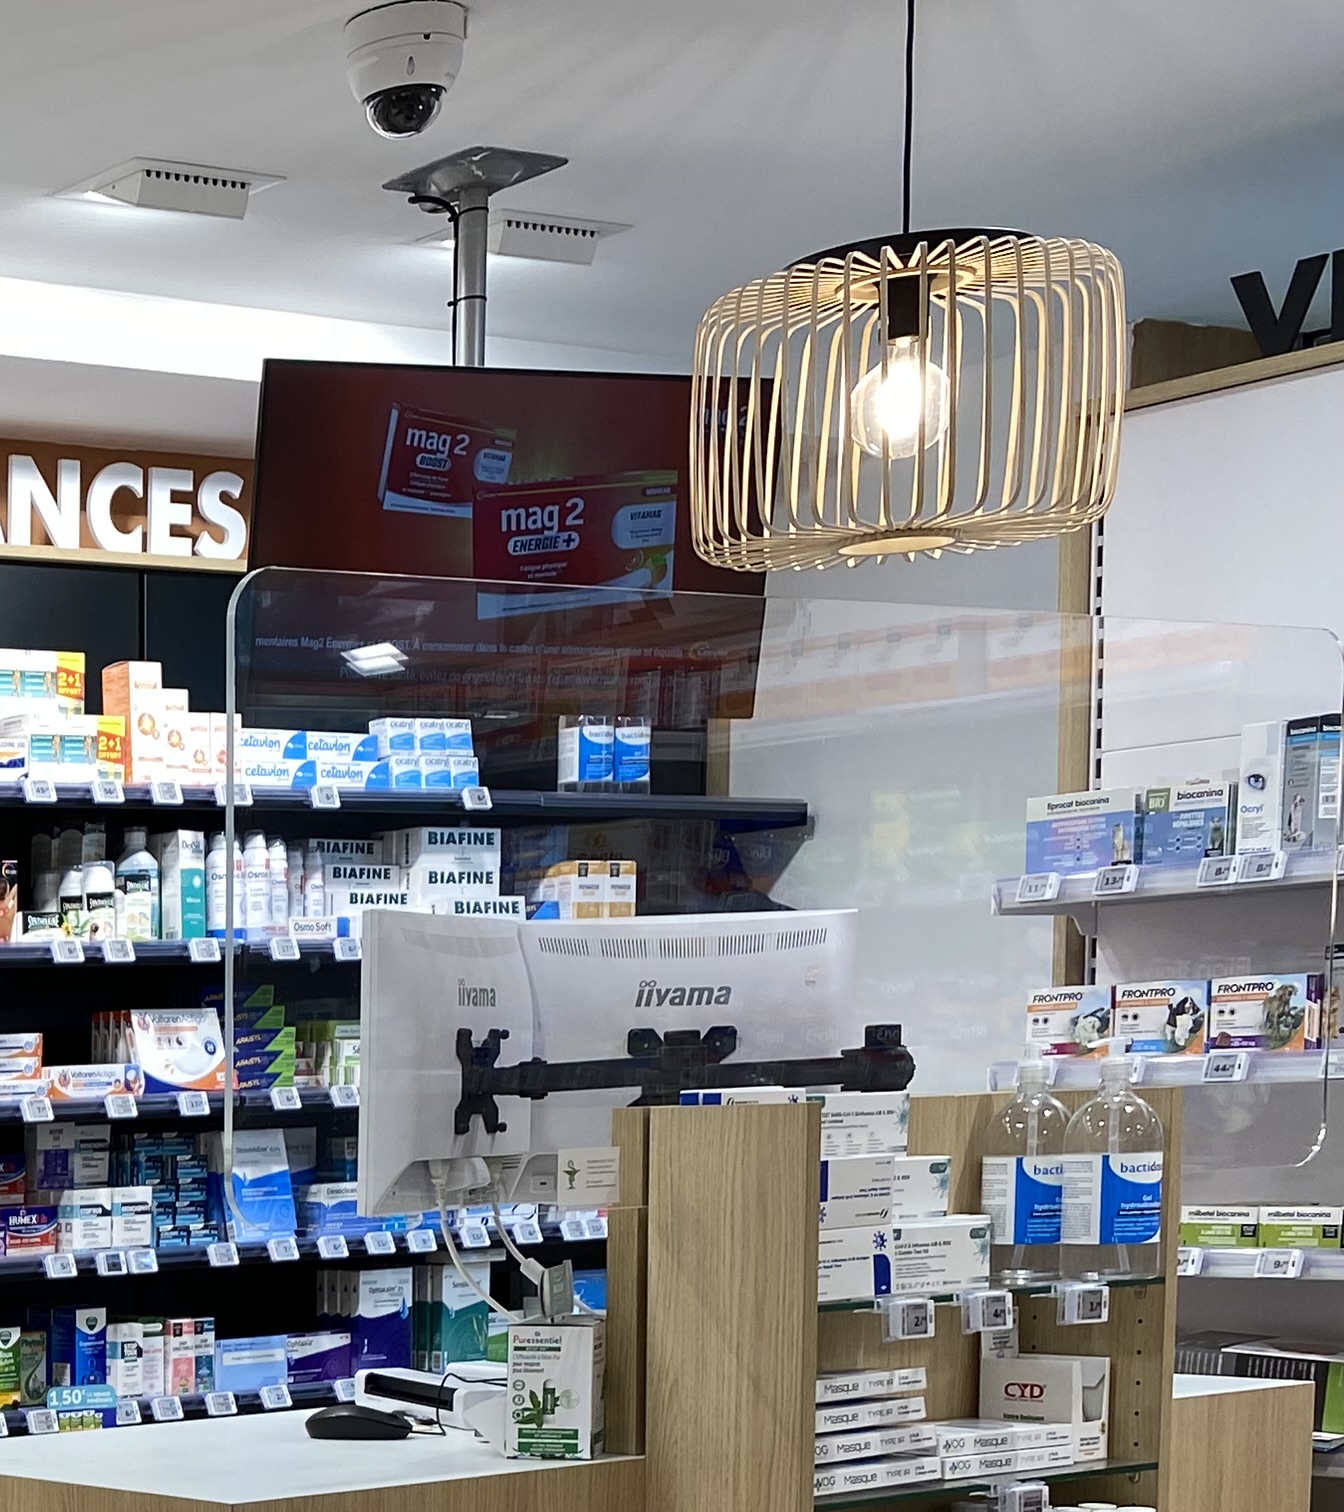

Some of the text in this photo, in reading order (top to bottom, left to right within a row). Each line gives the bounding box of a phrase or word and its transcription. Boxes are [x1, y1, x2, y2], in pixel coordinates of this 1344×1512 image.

[406, 427, 471, 457] mag 2
[419, 456, 449, 469] BOOST
[501, 497, 584, 537] mag 2
[512, 537, 561, 554] ENERGIE
[58, 672, 82, 685] 2+1
[308, 739, 351, 755] cetavlon
[1177, 788, 1224, 801] biocanina
[427, 832, 495, 846] BIAFINE
[333, 867, 391, 880] BIAFINE
[635, 980, 732, 1008] iiyama
[1032, 992, 1084, 1005] FRONTPRO
[513, 1336, 562, 1344] Puressentiel
[824, 1383, 859, 1394] Masque
